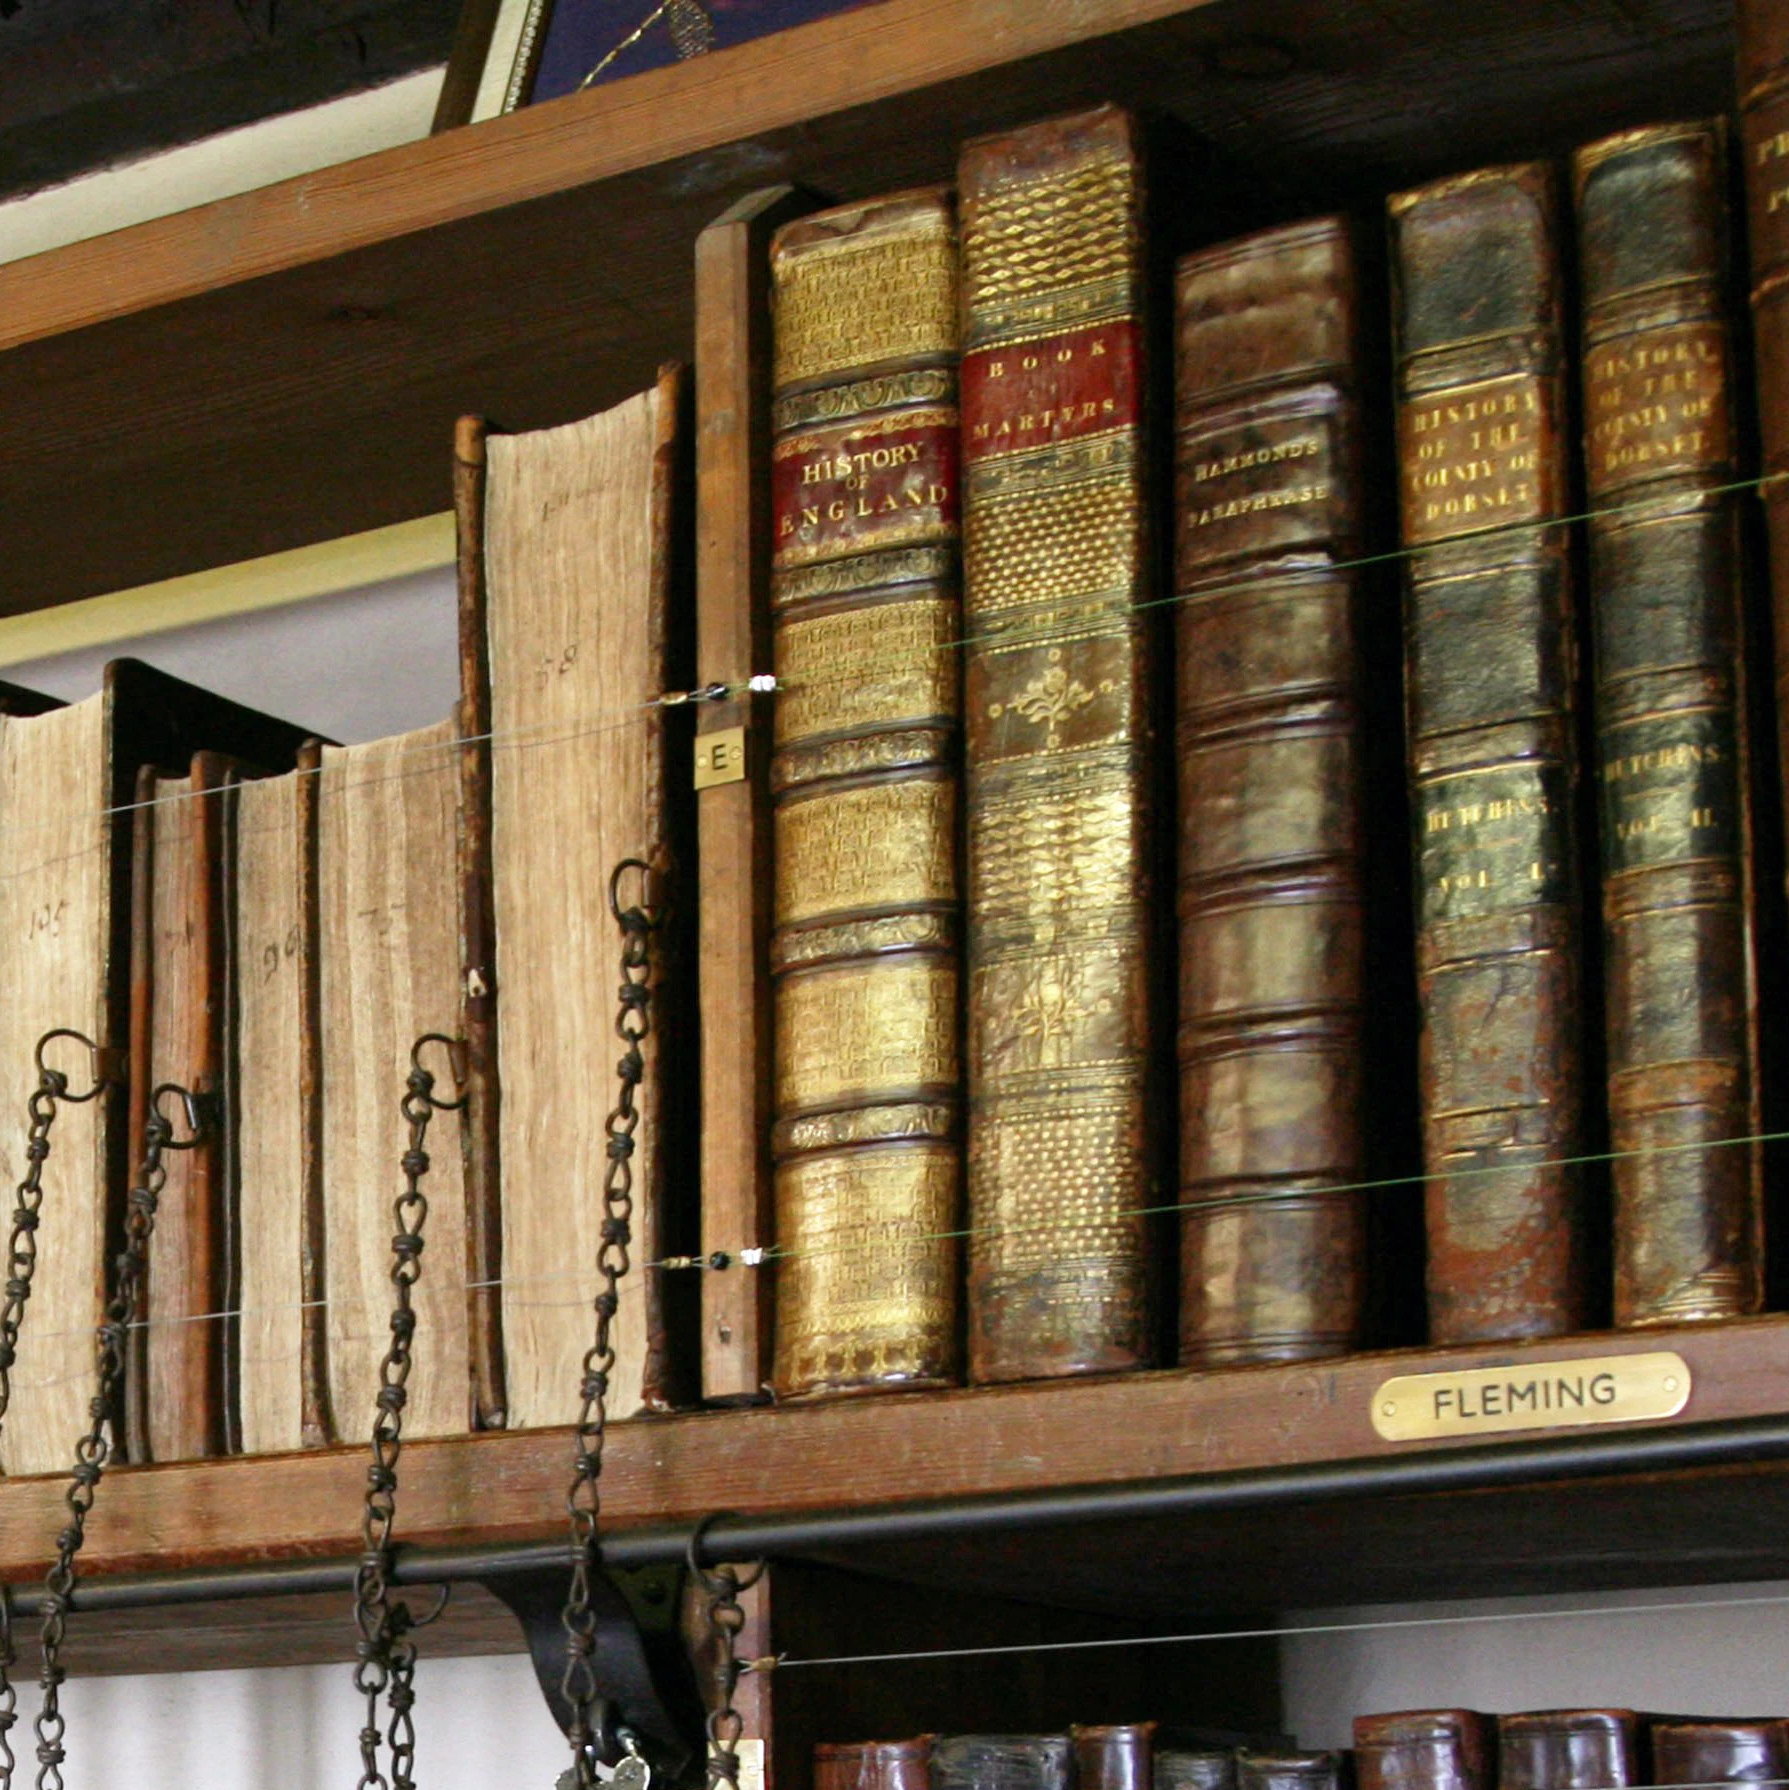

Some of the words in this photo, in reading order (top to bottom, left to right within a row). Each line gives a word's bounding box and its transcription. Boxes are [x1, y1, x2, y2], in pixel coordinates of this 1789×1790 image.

[989, 339, 1106, 378] BOOK
[973, 398, 1114, 439] MARTYRS
[1414, 392, 1535, 432] HISTORY
[802, 441, 924, 485] HISTORY
[1195, 440, 1319, 482] HAMMONDS
[1605, 431, 1704, 472] DORSET
[845, 474, 870, 490] OF
[1412, 459, 1492, 492] COUNTY
[780, 484, 948, 537] ENGLAND
[1187, 485, 1329, 529] PARAPHRASE
[1425, 483, 1528, 521] DORSET
[712, 744, 728, 770] E
[1433, 1373, 1616, 1420] FLEMING
